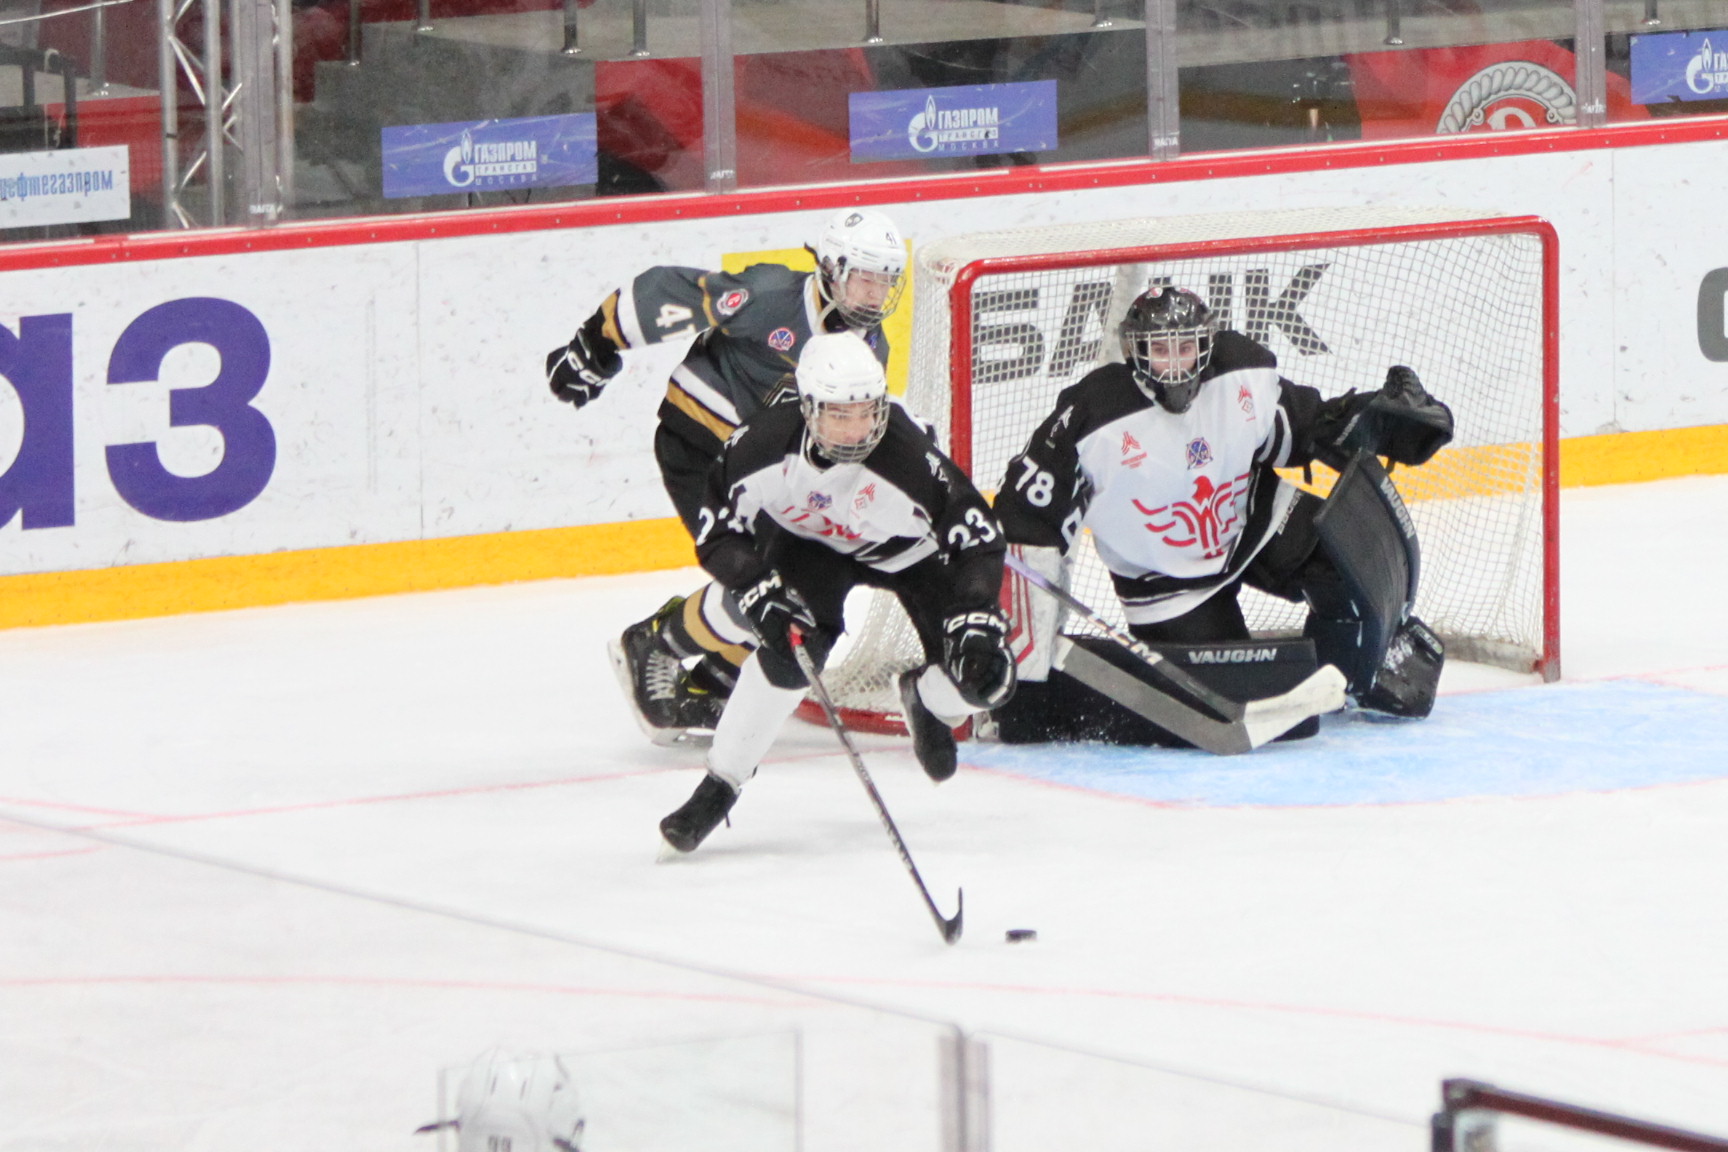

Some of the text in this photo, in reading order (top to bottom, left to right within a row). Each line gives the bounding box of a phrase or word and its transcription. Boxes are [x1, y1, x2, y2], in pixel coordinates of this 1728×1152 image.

[938, 107, 999, 129] ГАЗПРОМ
[474, 141, 537, 164] ГАЗПРОМ
[656, 303, 698, 343] 41
[566, 350, 613, 386] CC
[1012, 456, 1056, 509] 78
[1380, 475, 1417, 540] VAUGHN
[948, 506, 997, 551] 23
[1188, 648, 1278, 664] VAUGHN
